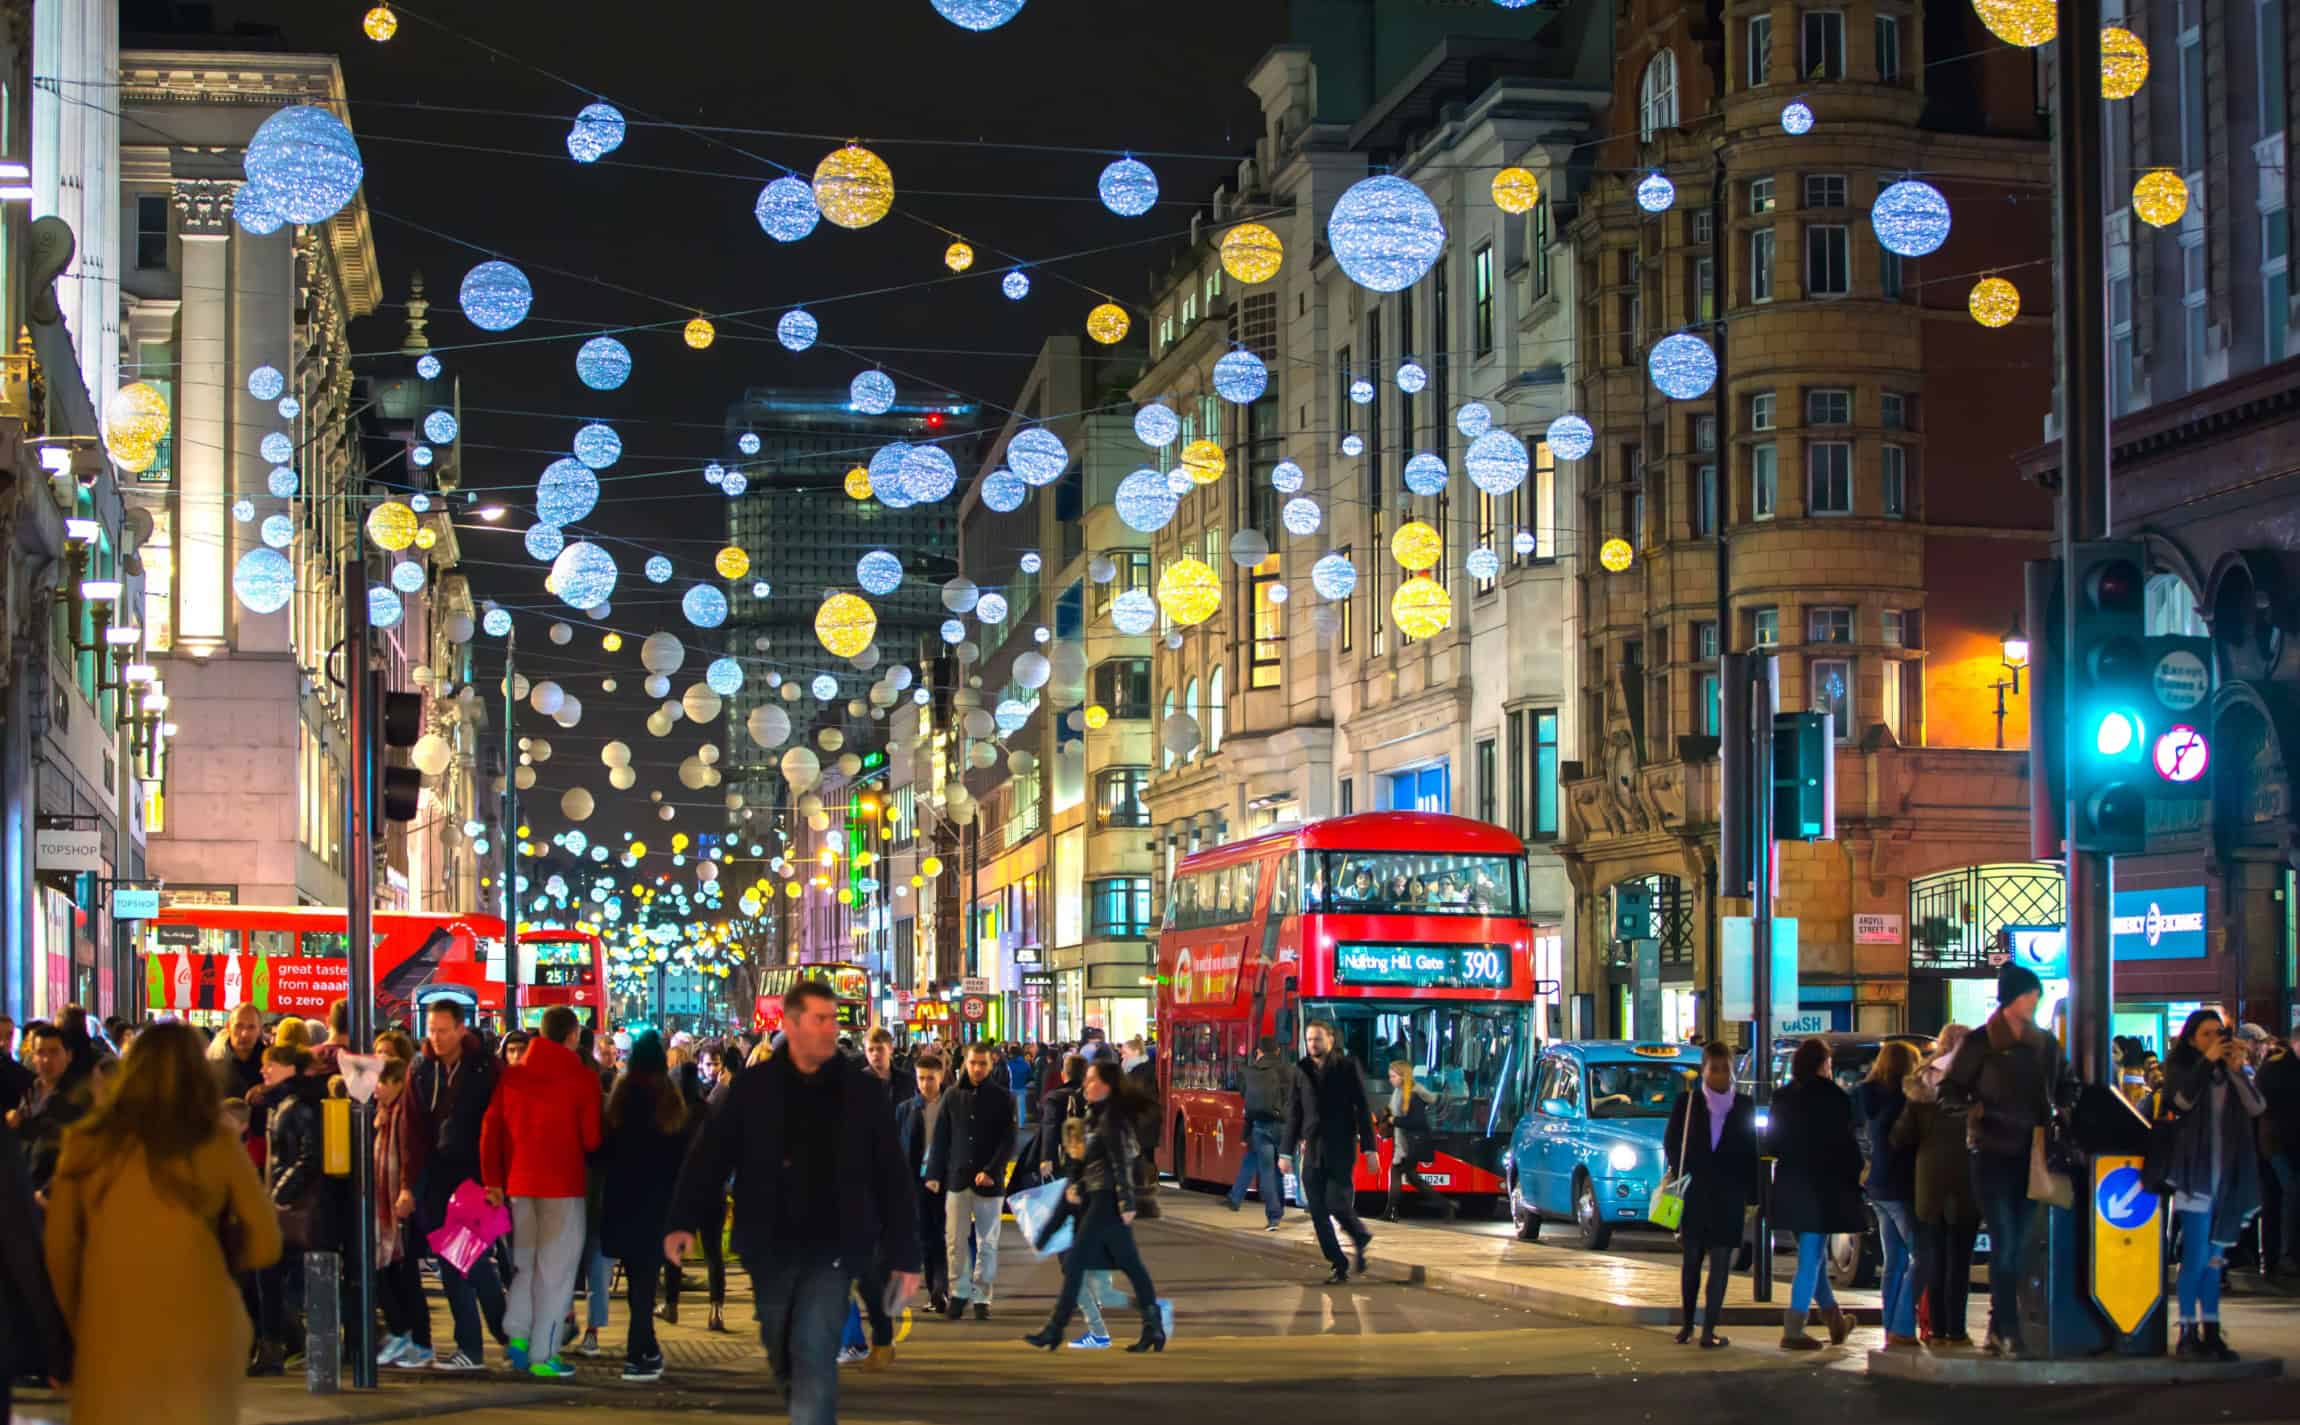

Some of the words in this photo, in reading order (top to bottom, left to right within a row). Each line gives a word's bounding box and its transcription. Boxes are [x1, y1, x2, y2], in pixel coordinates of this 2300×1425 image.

[41, 844, 98, 857] TOPSHOP
[117, 899, 157, 909] TOPSHOP
[1859, 916, 1883, 926] ARGYLL
[2160, 912, 2205, 933] EXCHANGE
[1858, 926, 1884, 935] STREET
[278, 964, 313, 977] great
[315, 965, 349, 976] taste
[1344, 954, 1388, 974] Notting
[1391, 955, 1412, 970] Hill
[1415, 954, 1445, 970] Gate
[1462, 951, 1500, 980] 390
[278, 978, 309, 990] from
[1023, 976, 1053, 985] ZARA
[278, 994, 292, 1006] to
[295, 996, 325, 1007] zero
[1781, 1016, 1822, 1033] CASH
